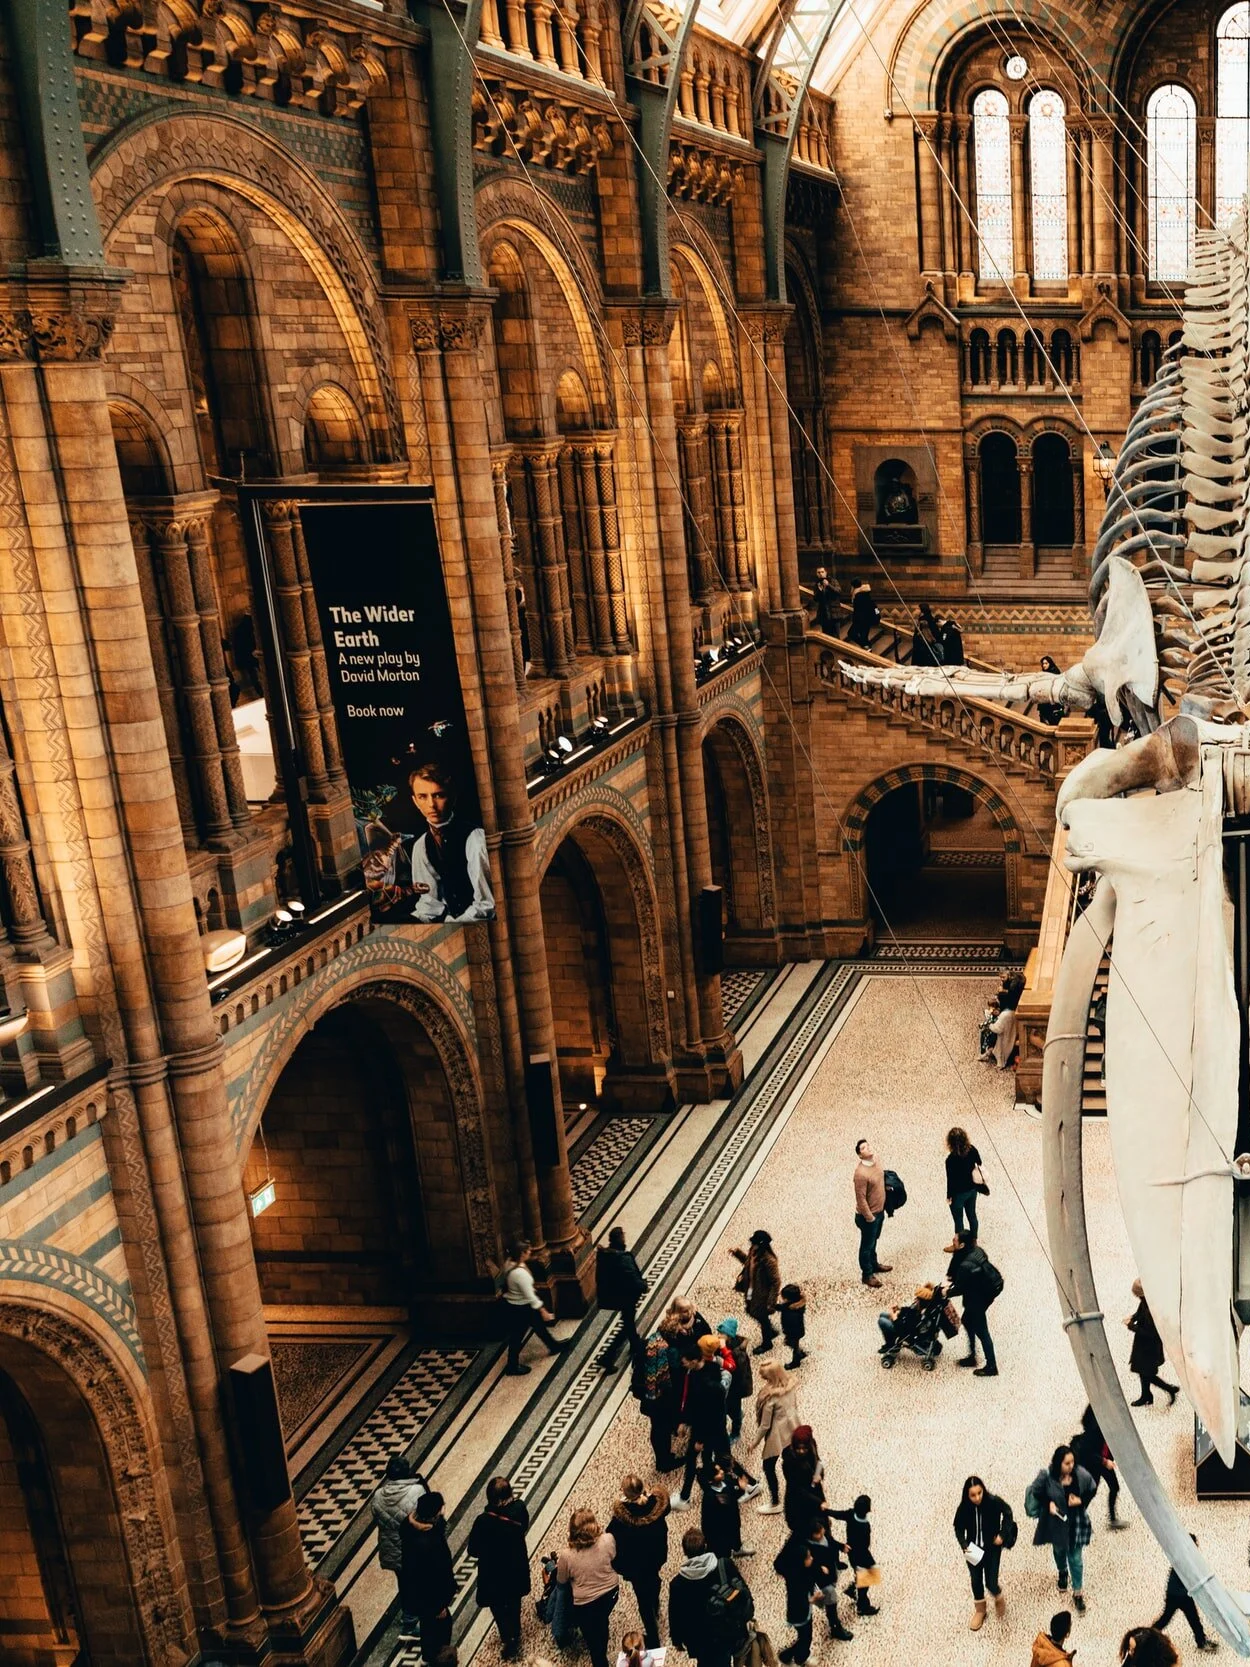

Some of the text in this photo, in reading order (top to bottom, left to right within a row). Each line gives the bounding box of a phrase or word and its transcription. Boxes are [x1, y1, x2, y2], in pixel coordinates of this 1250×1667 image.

[329, 605, 415, 624] The Wider
[334, 630, 380, 648] Earth
[338, 651, 420, 667] A new play by
[341, 669, 420, 682] David Morton
[346, 704, 404, 717] Book now
